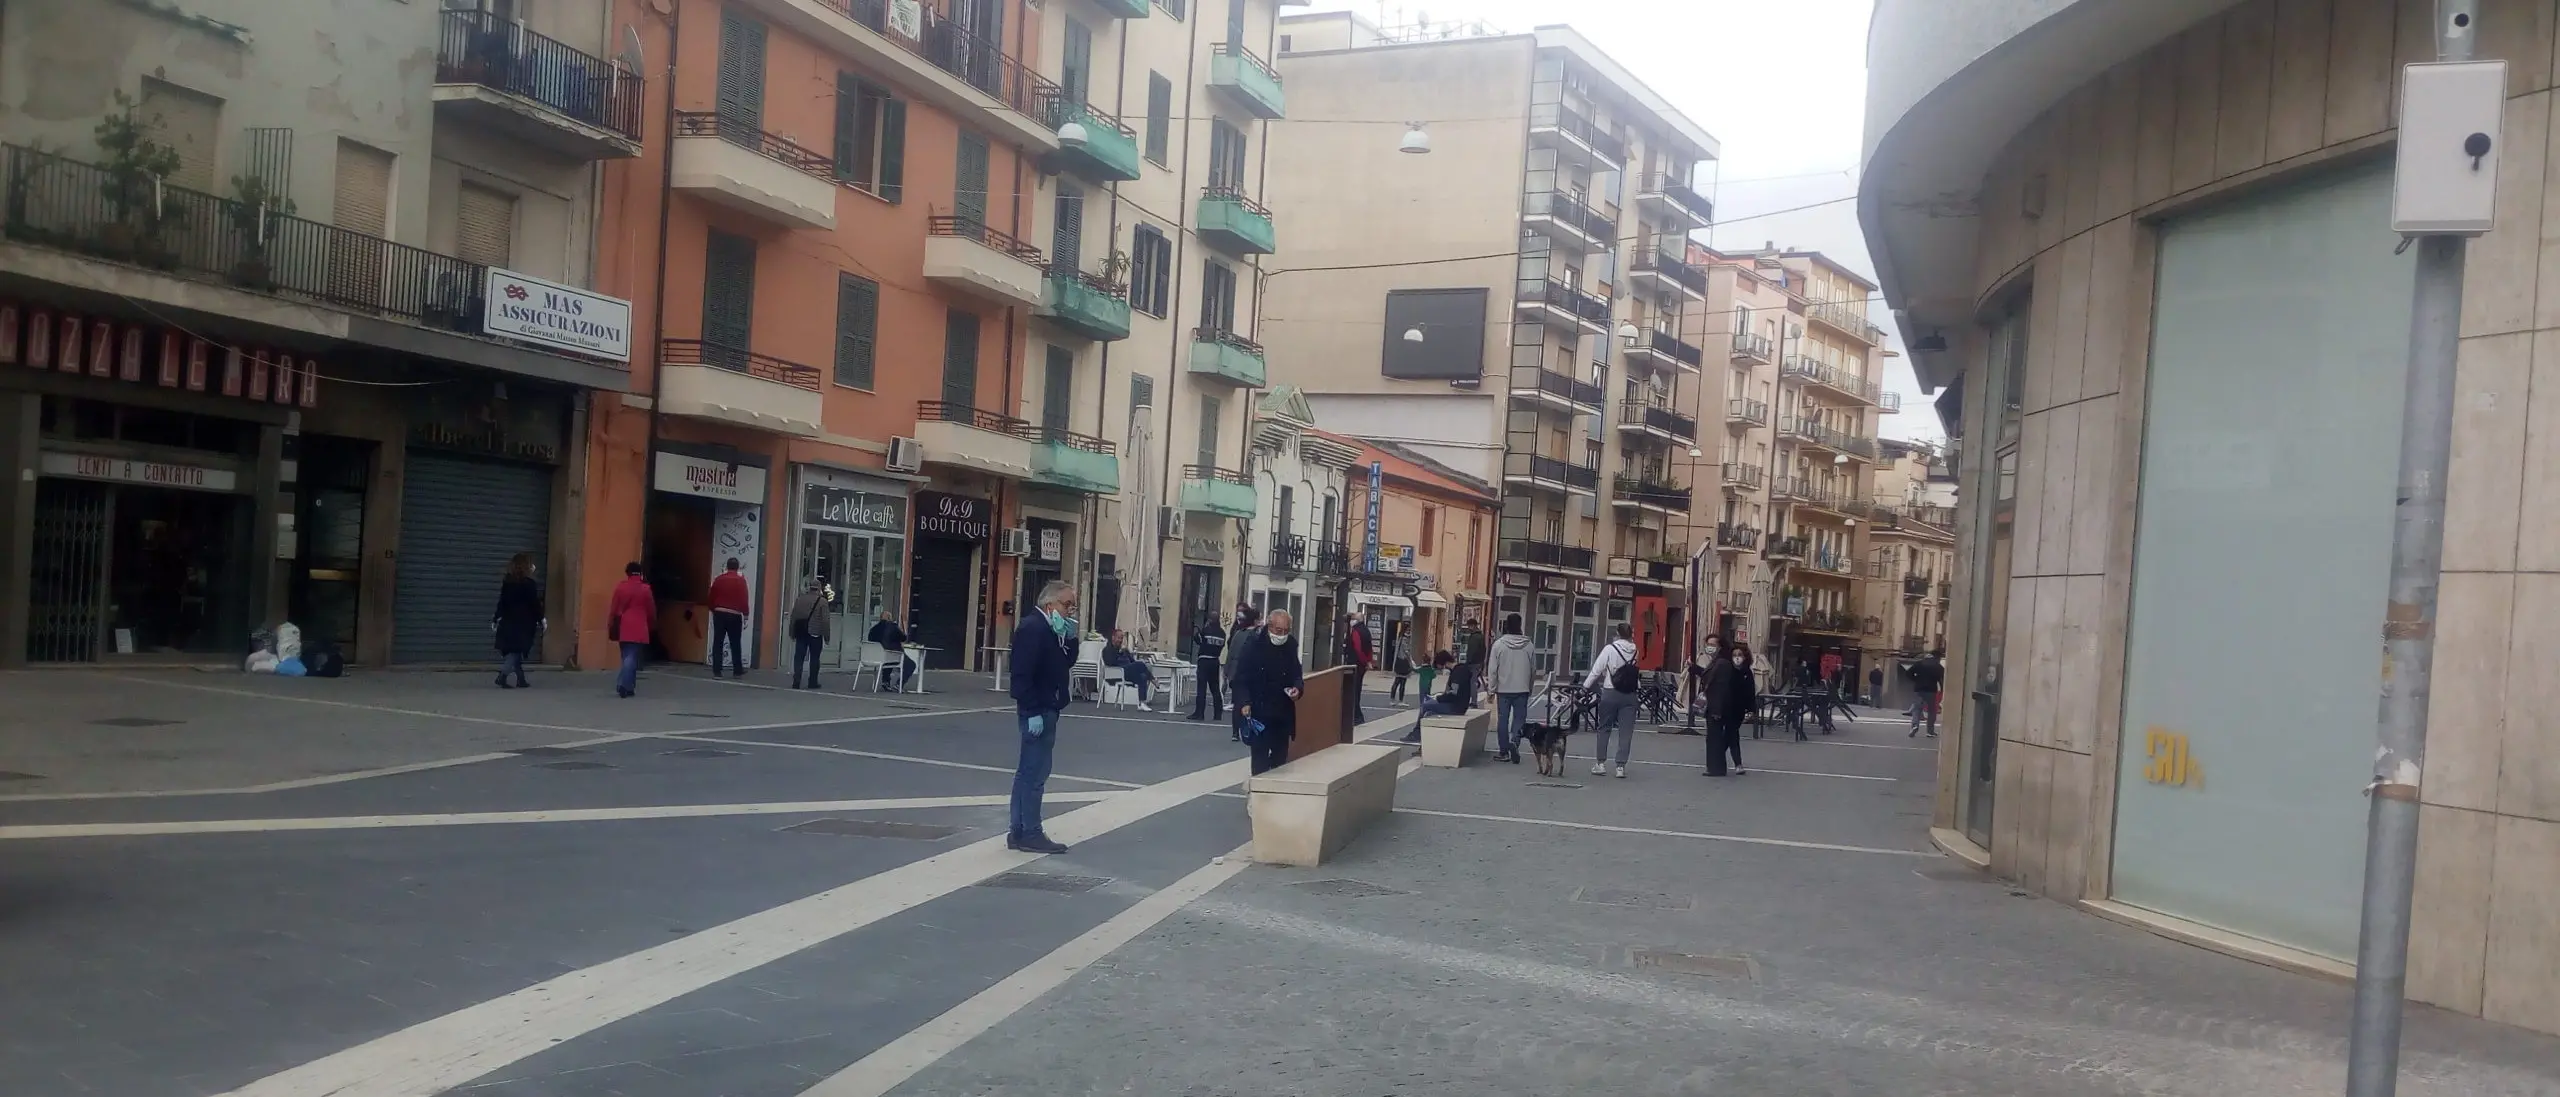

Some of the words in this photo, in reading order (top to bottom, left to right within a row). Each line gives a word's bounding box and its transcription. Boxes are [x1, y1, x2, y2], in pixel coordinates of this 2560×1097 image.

[542, 291, 583, 316] MAS
[498, 303, 620, 342] ASSICURAZIONI
[77, 457, 112, 477] LENTI
[124, 462, 132, 479] A
[144, 464, 203, 485] CONTATTO
[822, 495, 839, 521] Le
[843, 495, 870, 524] Vele
[938, 497, 973, 519] D&D
[920, 515, 988, 539] BOUTIQUE
